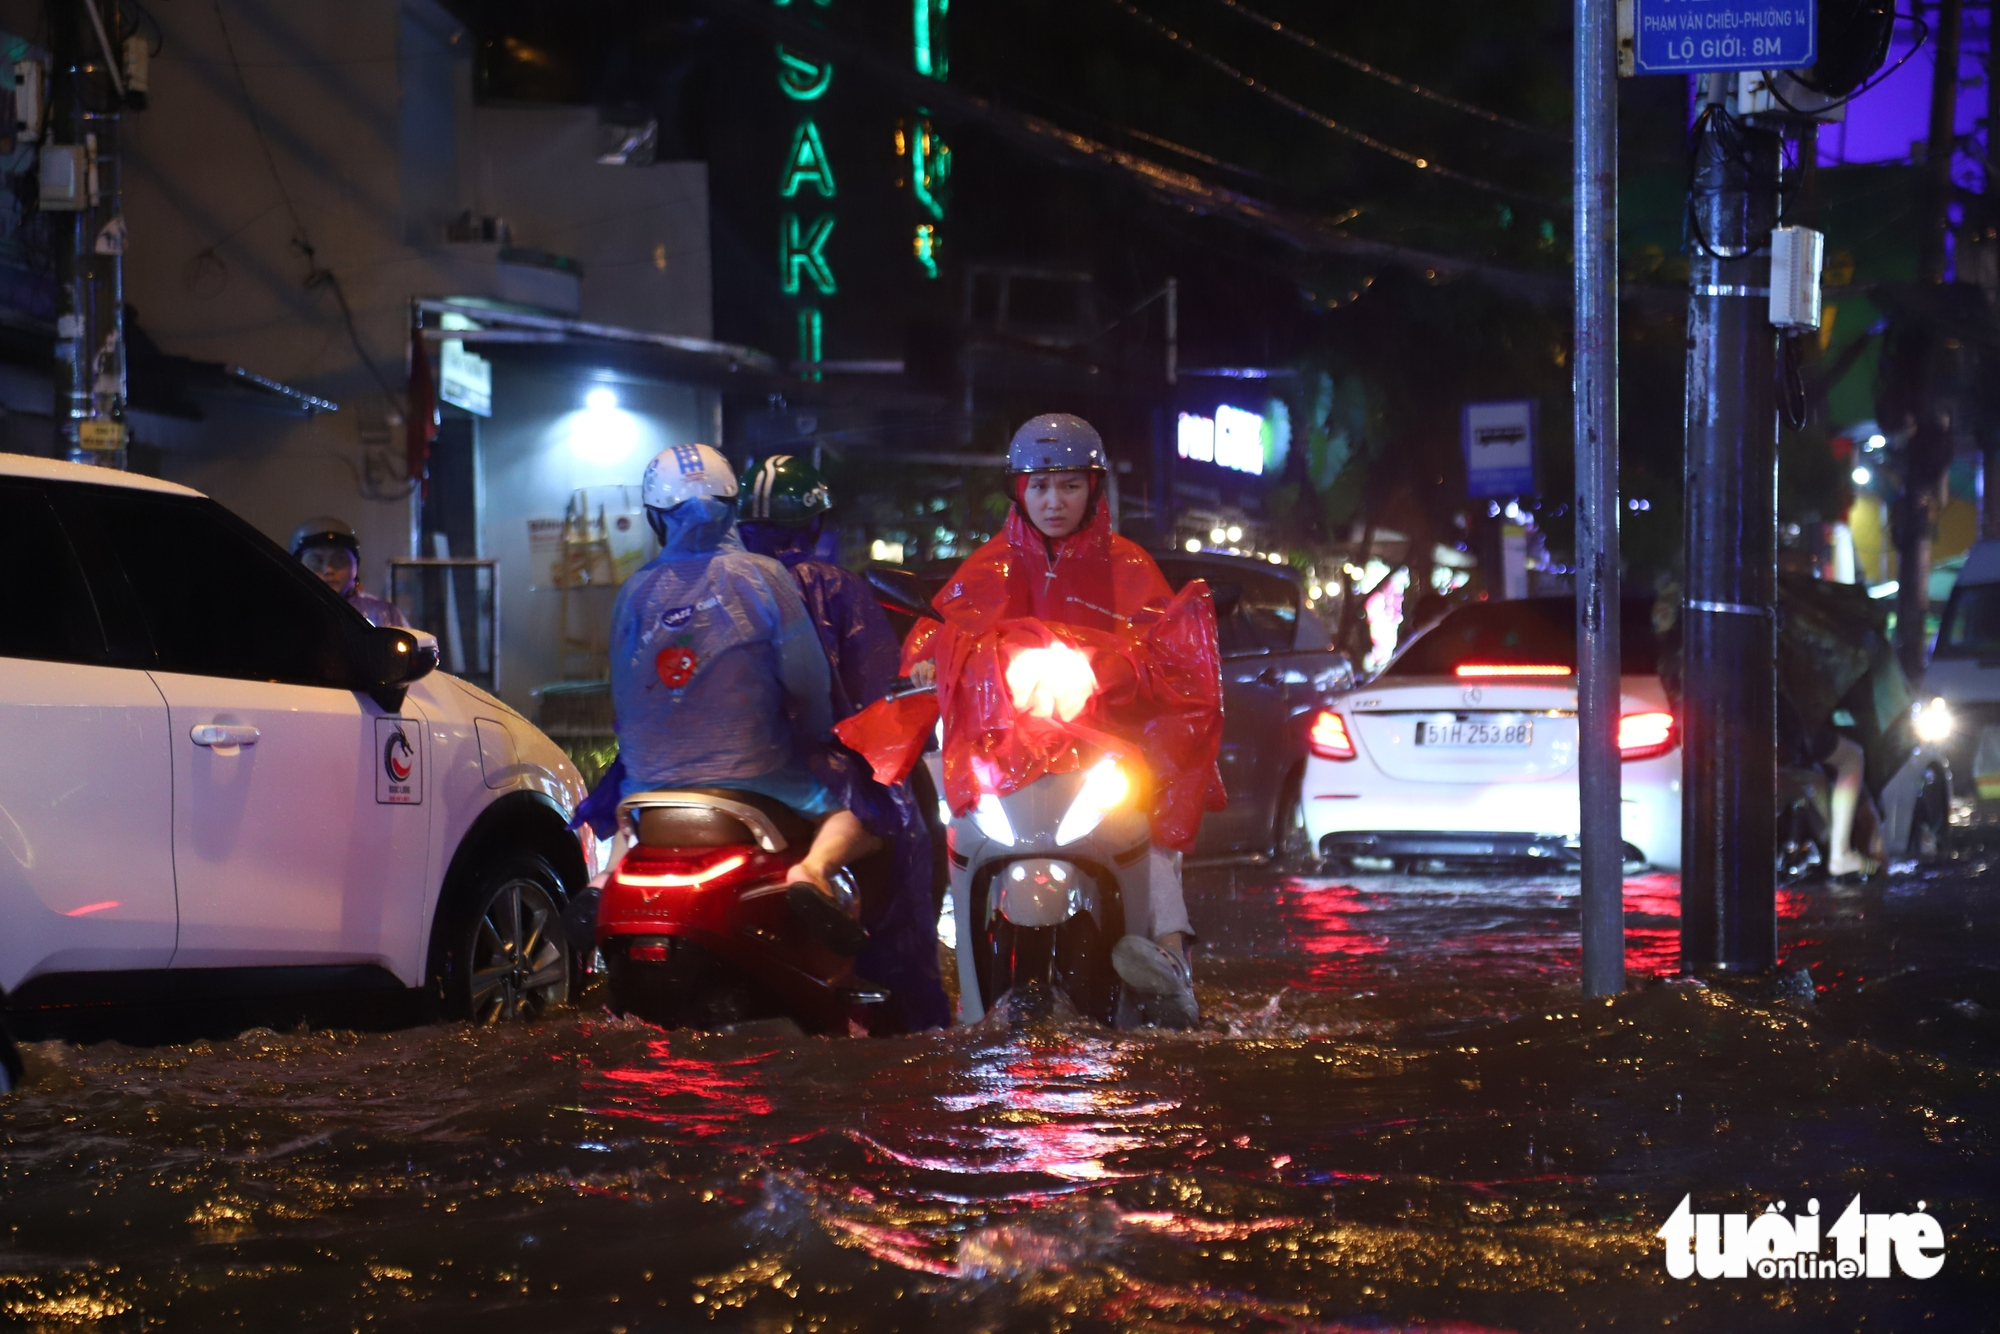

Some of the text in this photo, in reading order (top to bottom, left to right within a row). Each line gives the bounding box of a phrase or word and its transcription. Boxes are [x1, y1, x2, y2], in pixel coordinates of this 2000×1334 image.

[1644, 14, 1677, 35] PHẠM
[1679, 10, 1703, 30] VĂN
[1795, 10, 1805, 26] 14
[1668, 34, 1781, 63] LỘ GIỚI: 8M
[775, 0, 836, 382] SAKI
